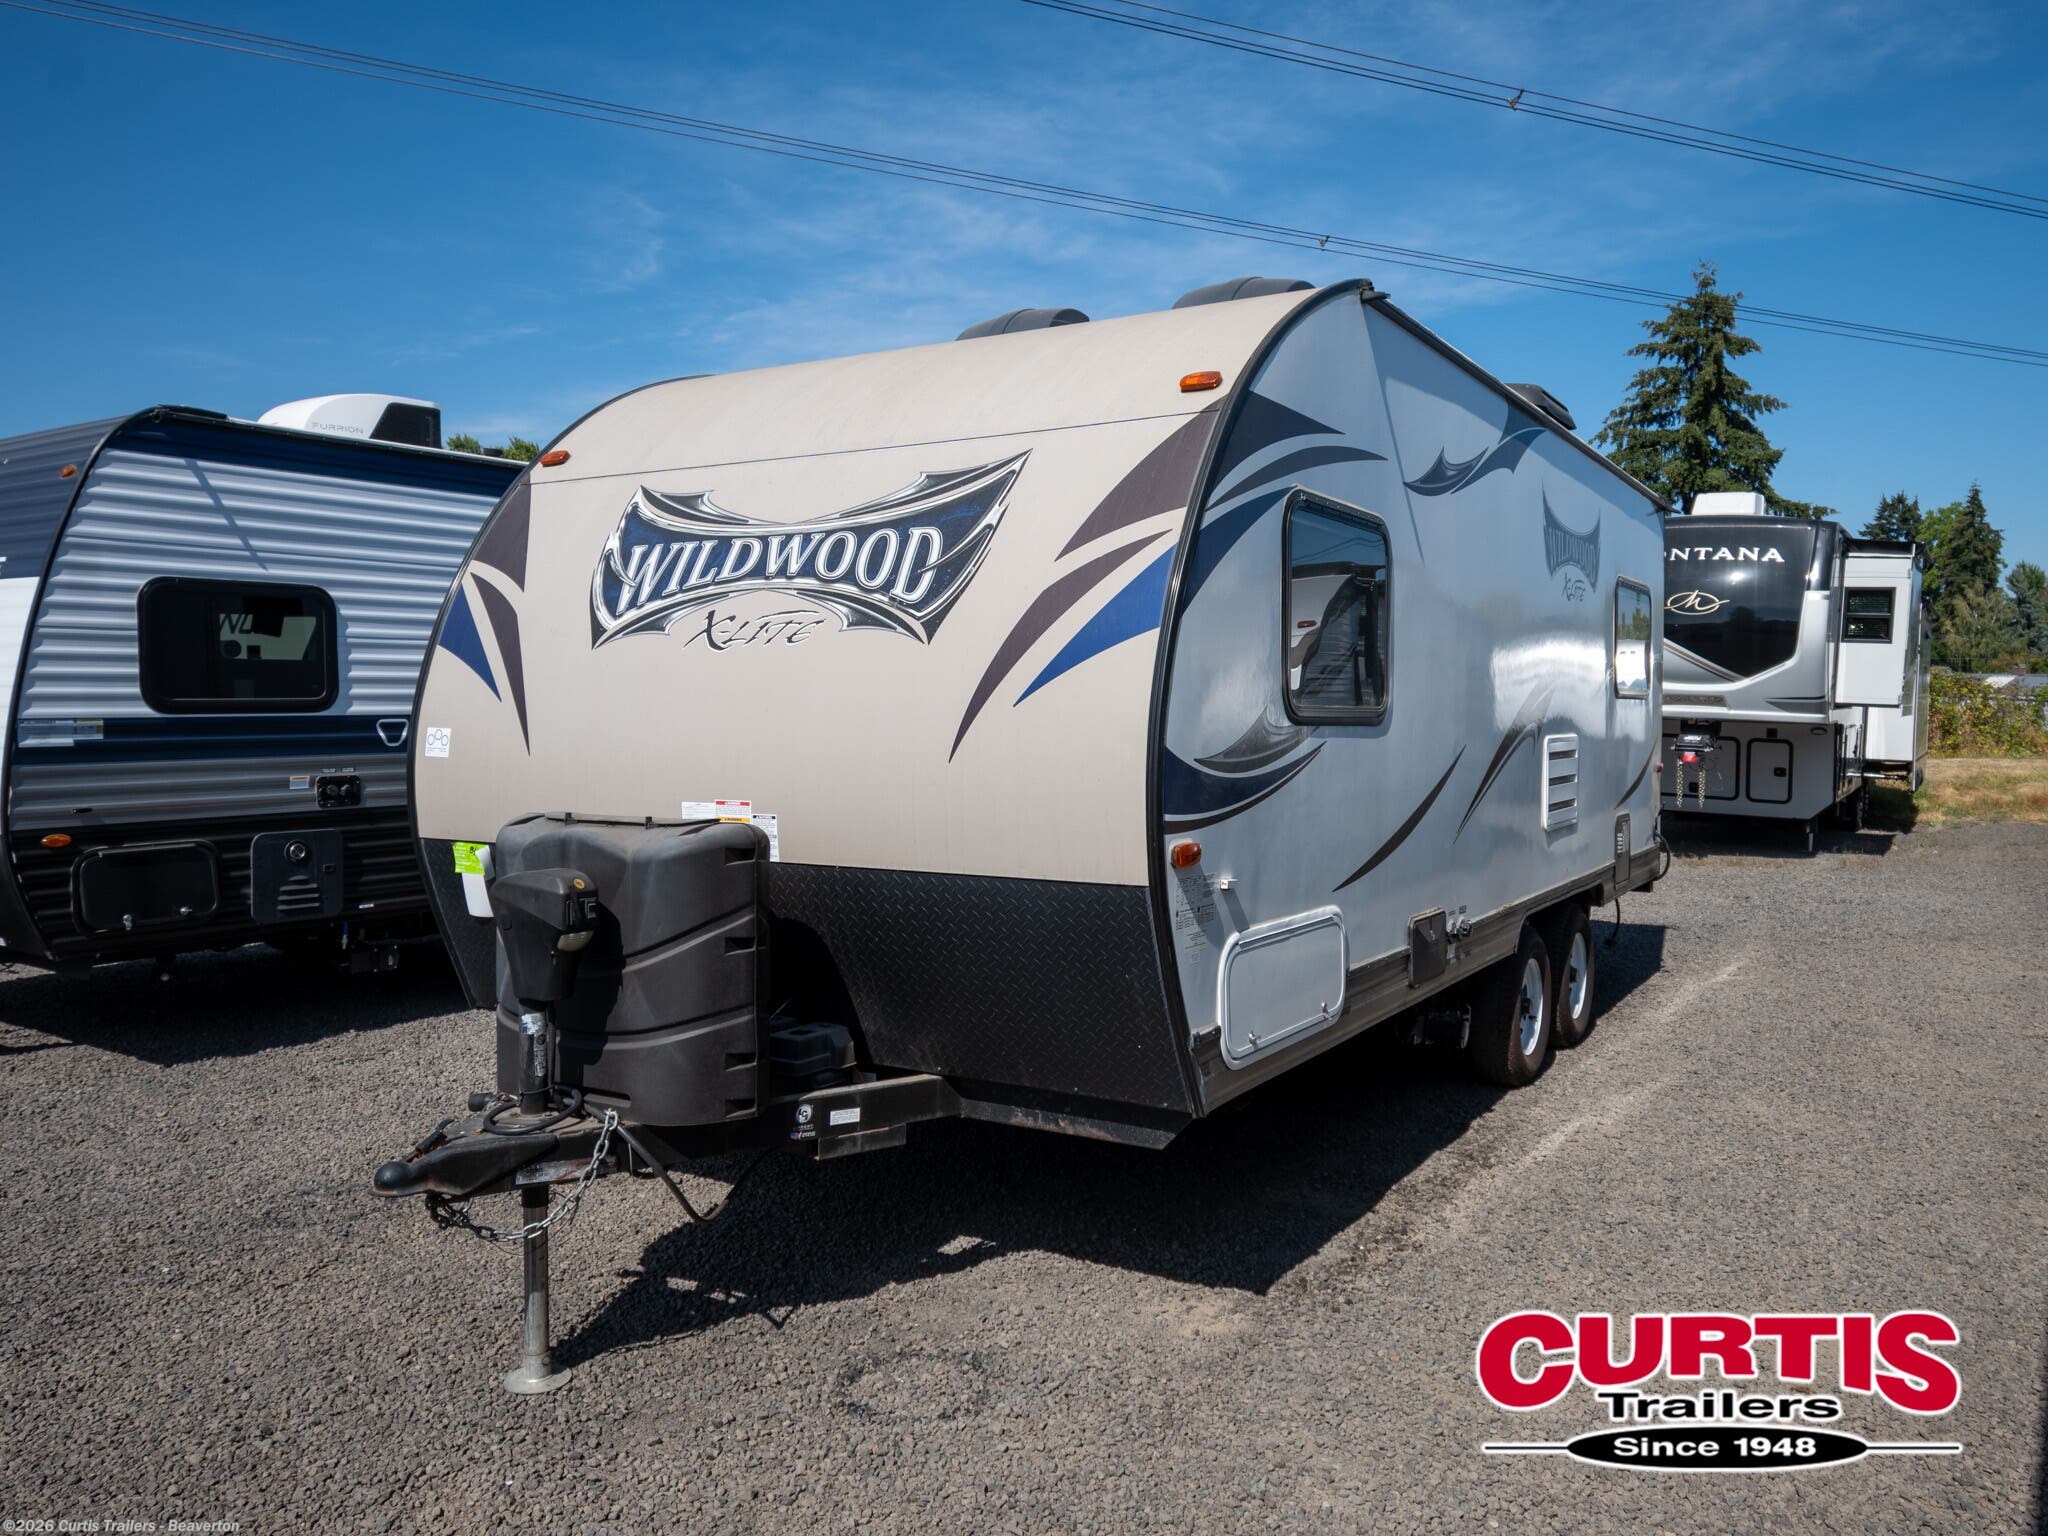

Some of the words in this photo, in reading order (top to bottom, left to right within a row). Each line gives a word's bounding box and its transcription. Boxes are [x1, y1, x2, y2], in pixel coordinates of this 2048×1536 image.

[311, 422, 364, 434] FURRION
[616, 526, 943, 617] WILDWOOD
[1547, 527, 1597, 585] WILDWOOD
[1663, 546, 1785, 562] NTANA
[682, 609, 827, 652] X-LITE
